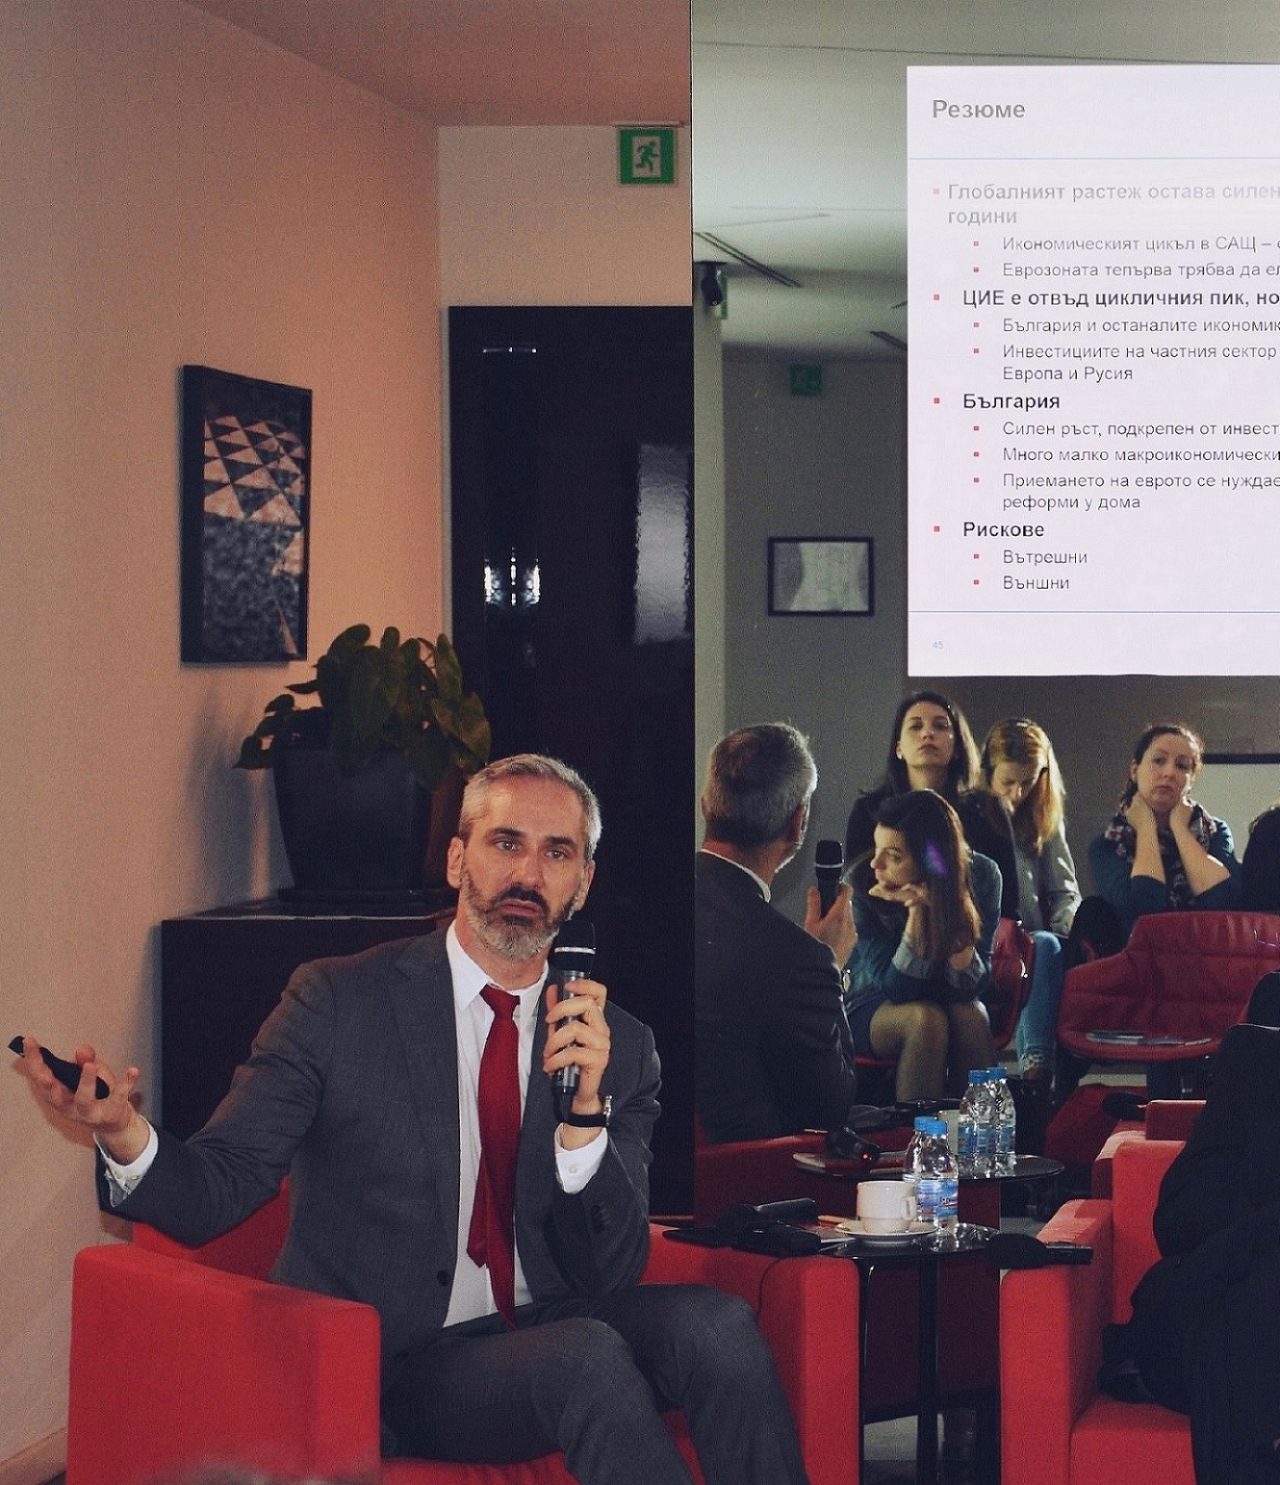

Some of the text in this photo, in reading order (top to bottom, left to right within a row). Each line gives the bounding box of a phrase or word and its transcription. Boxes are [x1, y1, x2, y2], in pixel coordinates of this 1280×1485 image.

[932, 99, 1026, 120] Резюме
[948, 183, 1067, 201] Глобалният
[1072, 186, 1142, 204] растеж
[1147, 186, 1216, 200] остава
[948, 211, 1017, 227] години
[1003, 236, 1140, 252] Икономическият
[1145, 239, 1196, 254] цикъл
[1200, 239, 1210, 251] в
[1215, 235, 1257, 254] САЩ
[1003, 262, 1099, 280] Еврозоната
[1104, 265, 1172, 280] тепърва
[1177, 261, 1235, 280] трябва
[1239, 265, 1261, 279] да
[963, 289, 1005, 309] ЦИЕ
[1010, 293, 1022, 306] е
[1027, 292, 1090, 308] отвъд
[1095, 292, 1203, 308] цикличния
[1210, 291, 1250, 308] пик,
[1256, 292, 1280, 305] но
[1003, 317, 1082, 336] България
[1087, 321, 1097, 332] и
[1101, 320, 1198, 332] останалите
[1003, 344, 1120, 361] Инвестициите
[1125, 346, 1145, 359] на
[1150, 346, 1217, 358] частния
[1221, 346, 1277, 361] сектор
[1003, 365, 1133, 386] Европа и Русия
[963, 393, 1060, 413] България
[1002, 420, 1056, 436] Силен
[1061, 424, 1102, 439] ръст,
[1107, 424, 1195, 439] подкрепен
[1199, 424, 1217, 436] от
[1003, 447, 1054, 462] Много
[1058, 450, 1110, 462] малко
[1114, 450, 1280, 465] макроикономически
[1003, 472, 1105, 490] Приемането
[1110, 476, 1130, 488] на
[1134, 476, 1192, 491] еврото
[1196, 476, 1217, 488] се
[1002, 494, 1141, 512] реформи у дома
[963, 521, 1045, 538] Рискове
[1003, 549, 1088, 567] Вътрешни
[1003, 575, 1070, 590] Външни
